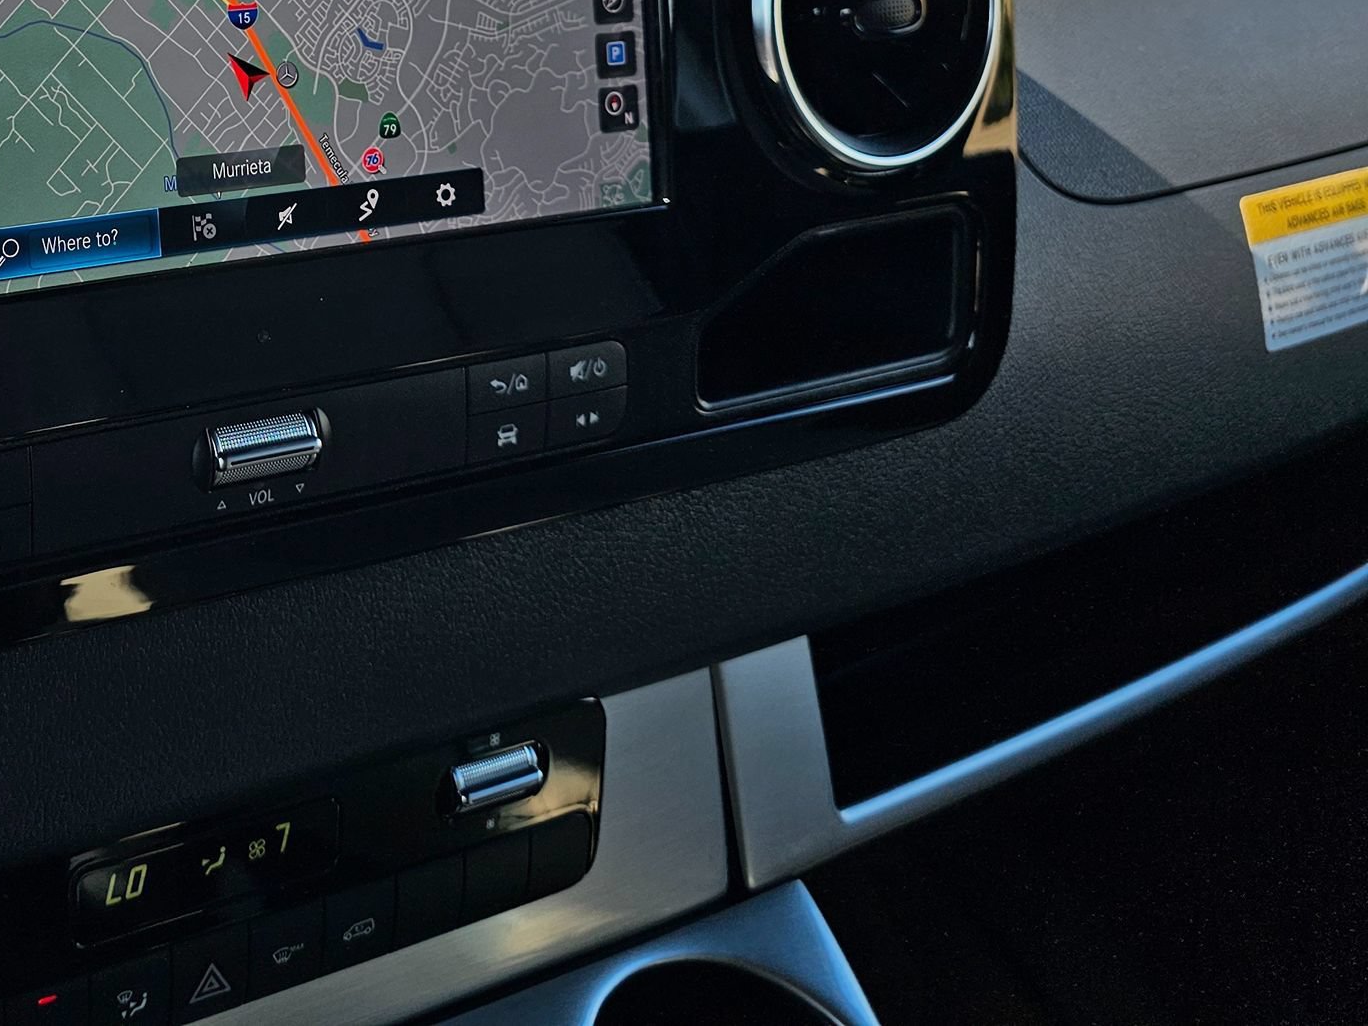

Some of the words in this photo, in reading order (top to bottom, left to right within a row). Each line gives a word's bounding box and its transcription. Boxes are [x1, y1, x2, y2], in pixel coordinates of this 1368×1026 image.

[237, 11, 251, 25] 15
[624, 111, 635, 125] N
[383, 124, 397, 136] 79
[318, 133, 350, 184] Temecula
[365, 152, 379, 166] 76
[212, 159, 272, 180] Murrieta
[41, 234, 92, 255] Where
[95, 228, 120, 249] to?
[248, 488, 275, 506] VOL
[104, 863, 148, 906] LO
[275, 822, 292, 856] 7
